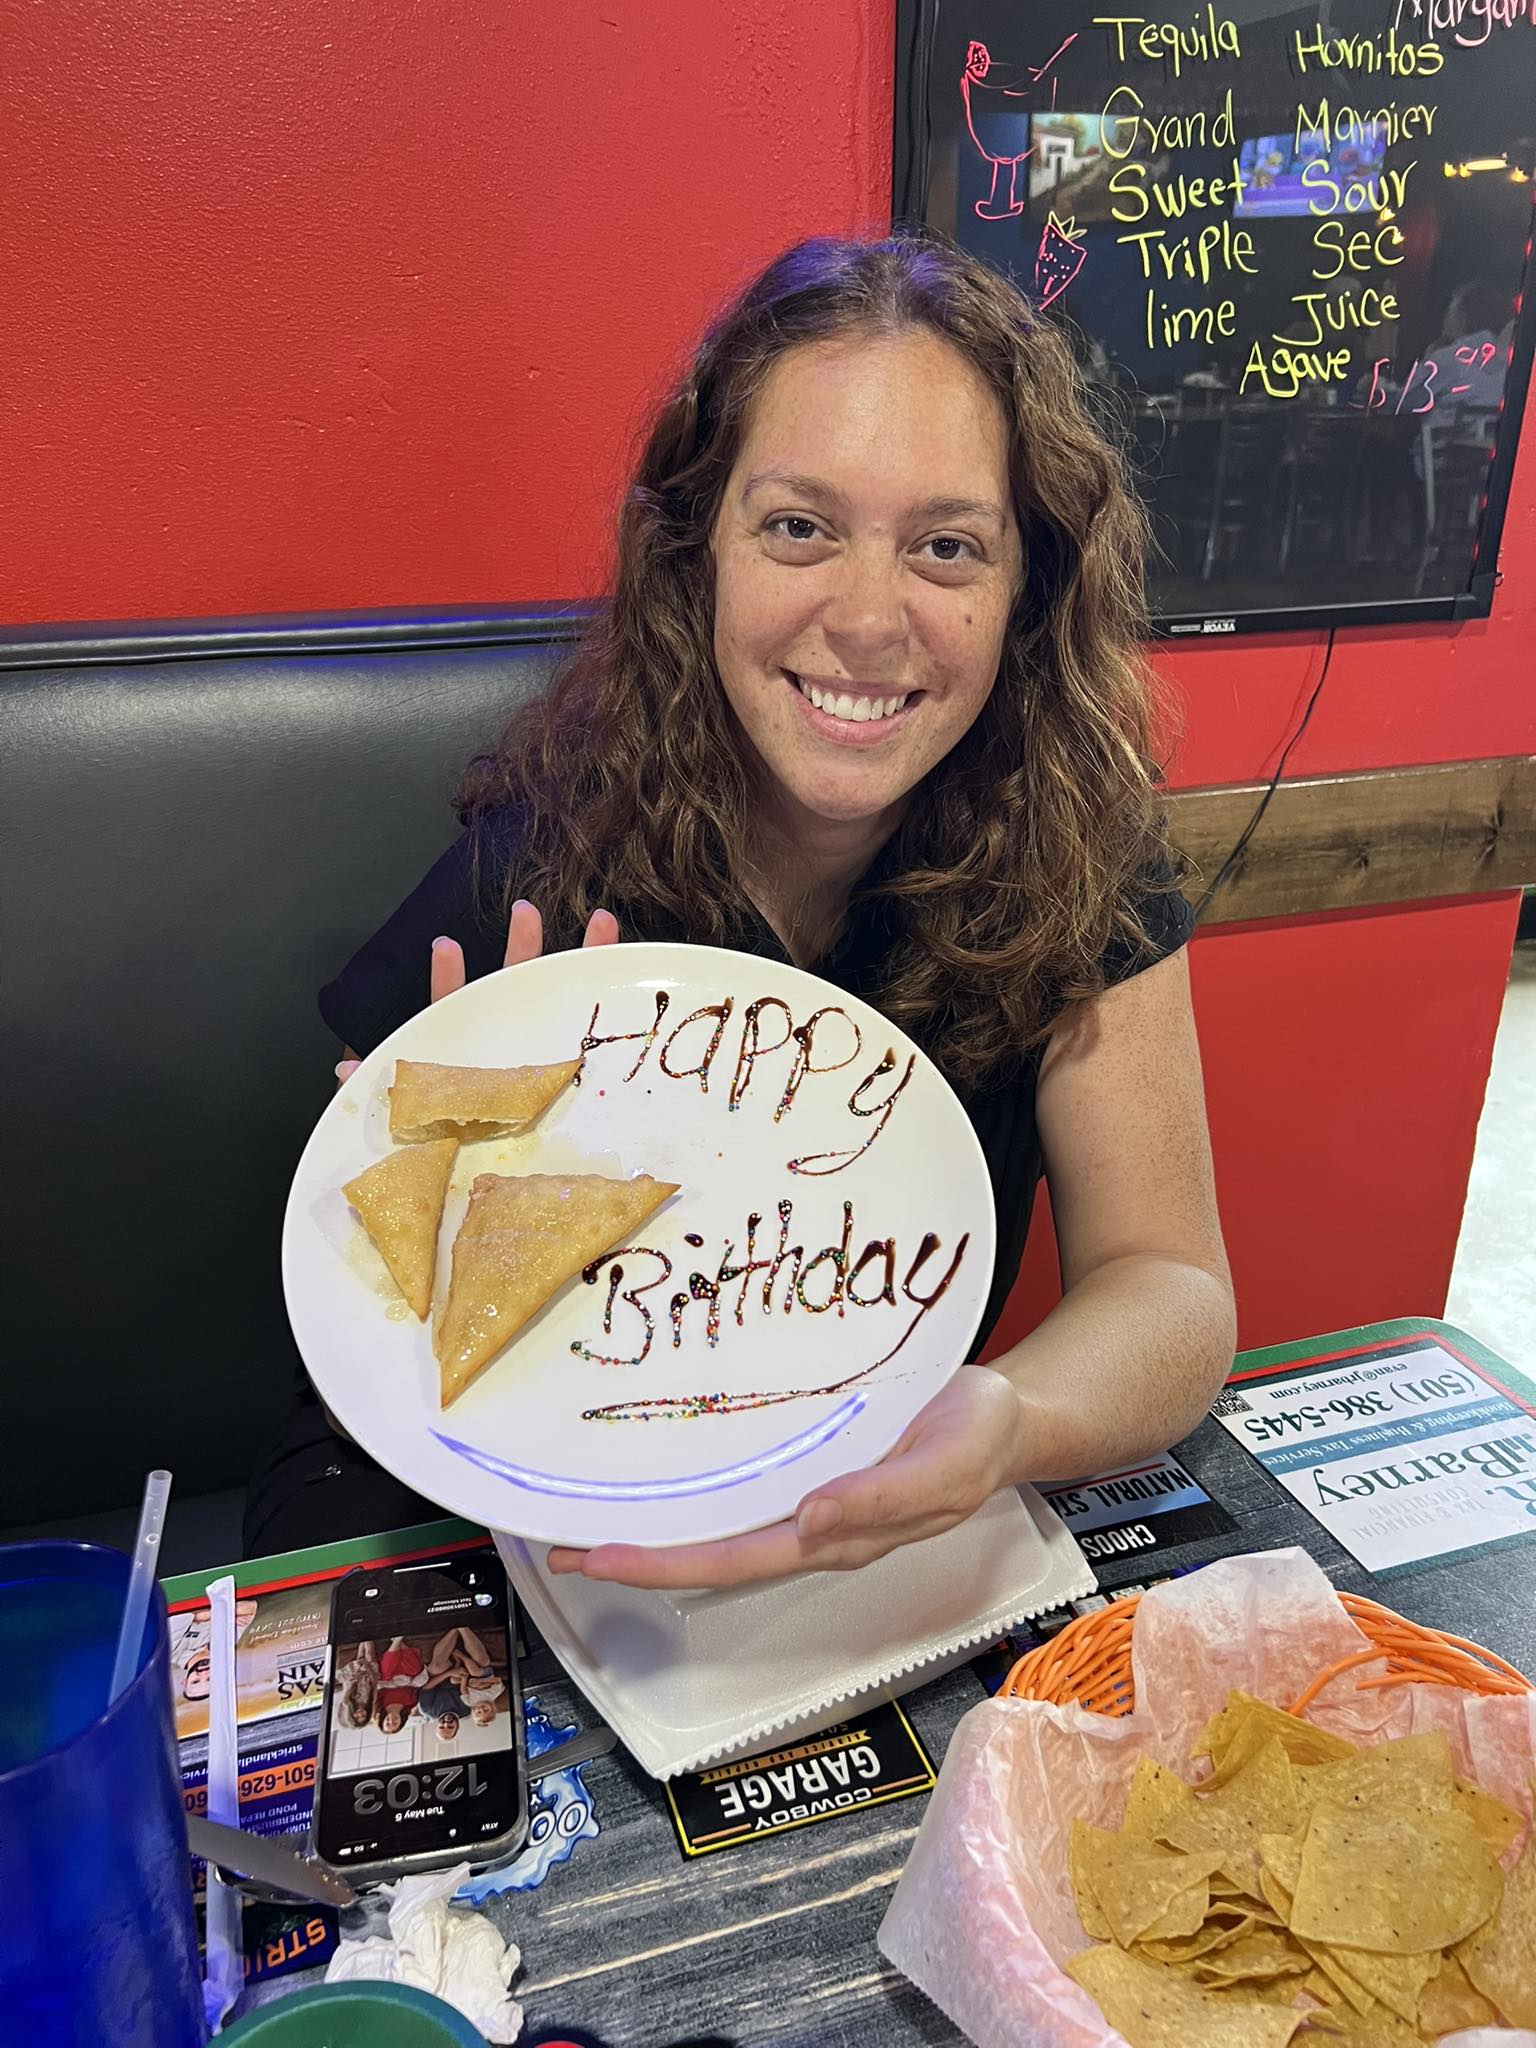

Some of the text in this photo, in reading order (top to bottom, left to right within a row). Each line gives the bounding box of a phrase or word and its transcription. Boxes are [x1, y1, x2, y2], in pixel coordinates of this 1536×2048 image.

[1093, 4, 1444, 78] Tequila Hornitos
[1099, 86, 1438, 158] Grand Marnier
[1108, 158, 1417, 222] Sweet Sour
[1117, 221, 1259, 284] Triple
[1146, 288, 1401, 349] lime Juice
[1240, 341, 1352, 398] Agave
[571, 991, 916, 1176] Happy
[570, 1199, 971, 1422] Birthday
[1244, 1370, 1475, 1441] (501) 386-5445
[1270, 1363, 1407, 1401] evan@jrbarney.com
[1262, 1402, 1514, 1467] Bookkeeping & Business Tax Services
[1088, 1468, 1194, 1507] NATURAL
[1312, 1442, 1529, 1507] Barney
[1080, 1524, 1157, 1560] CHOOS
[714, 1745, 881, 1818] GARAGE
[769, 1751, 794, 1763] AND
[353, 1762, 488, 1815] 12:03
[404, 1809, 425, 1819] May
[426, 1805, 445, 1816] Tue
[754, 1787, 872, 1830] COWBOY
